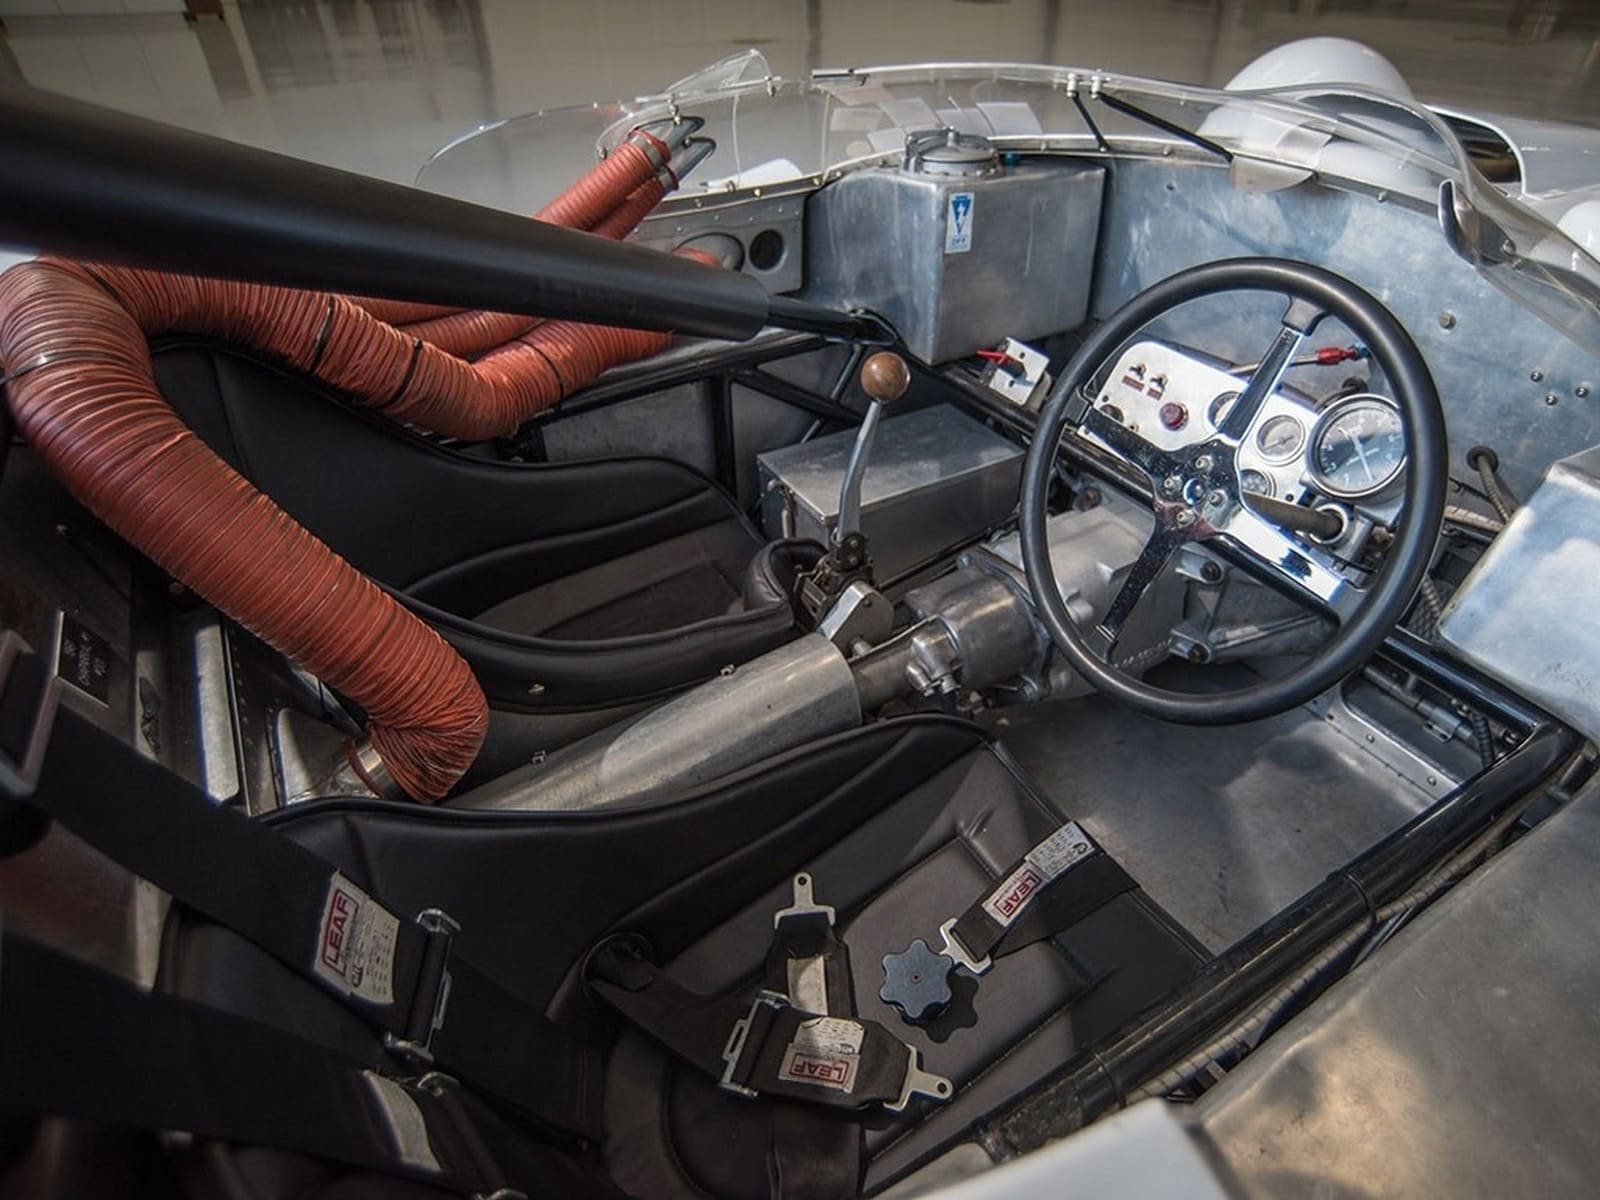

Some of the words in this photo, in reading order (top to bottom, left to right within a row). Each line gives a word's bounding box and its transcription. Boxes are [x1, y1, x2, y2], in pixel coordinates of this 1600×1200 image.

[1003, 875, 1037, 913] LEAF
[326, 895, 350, 965] LEAF
[793, 1061, 844, 1080] LEAF
